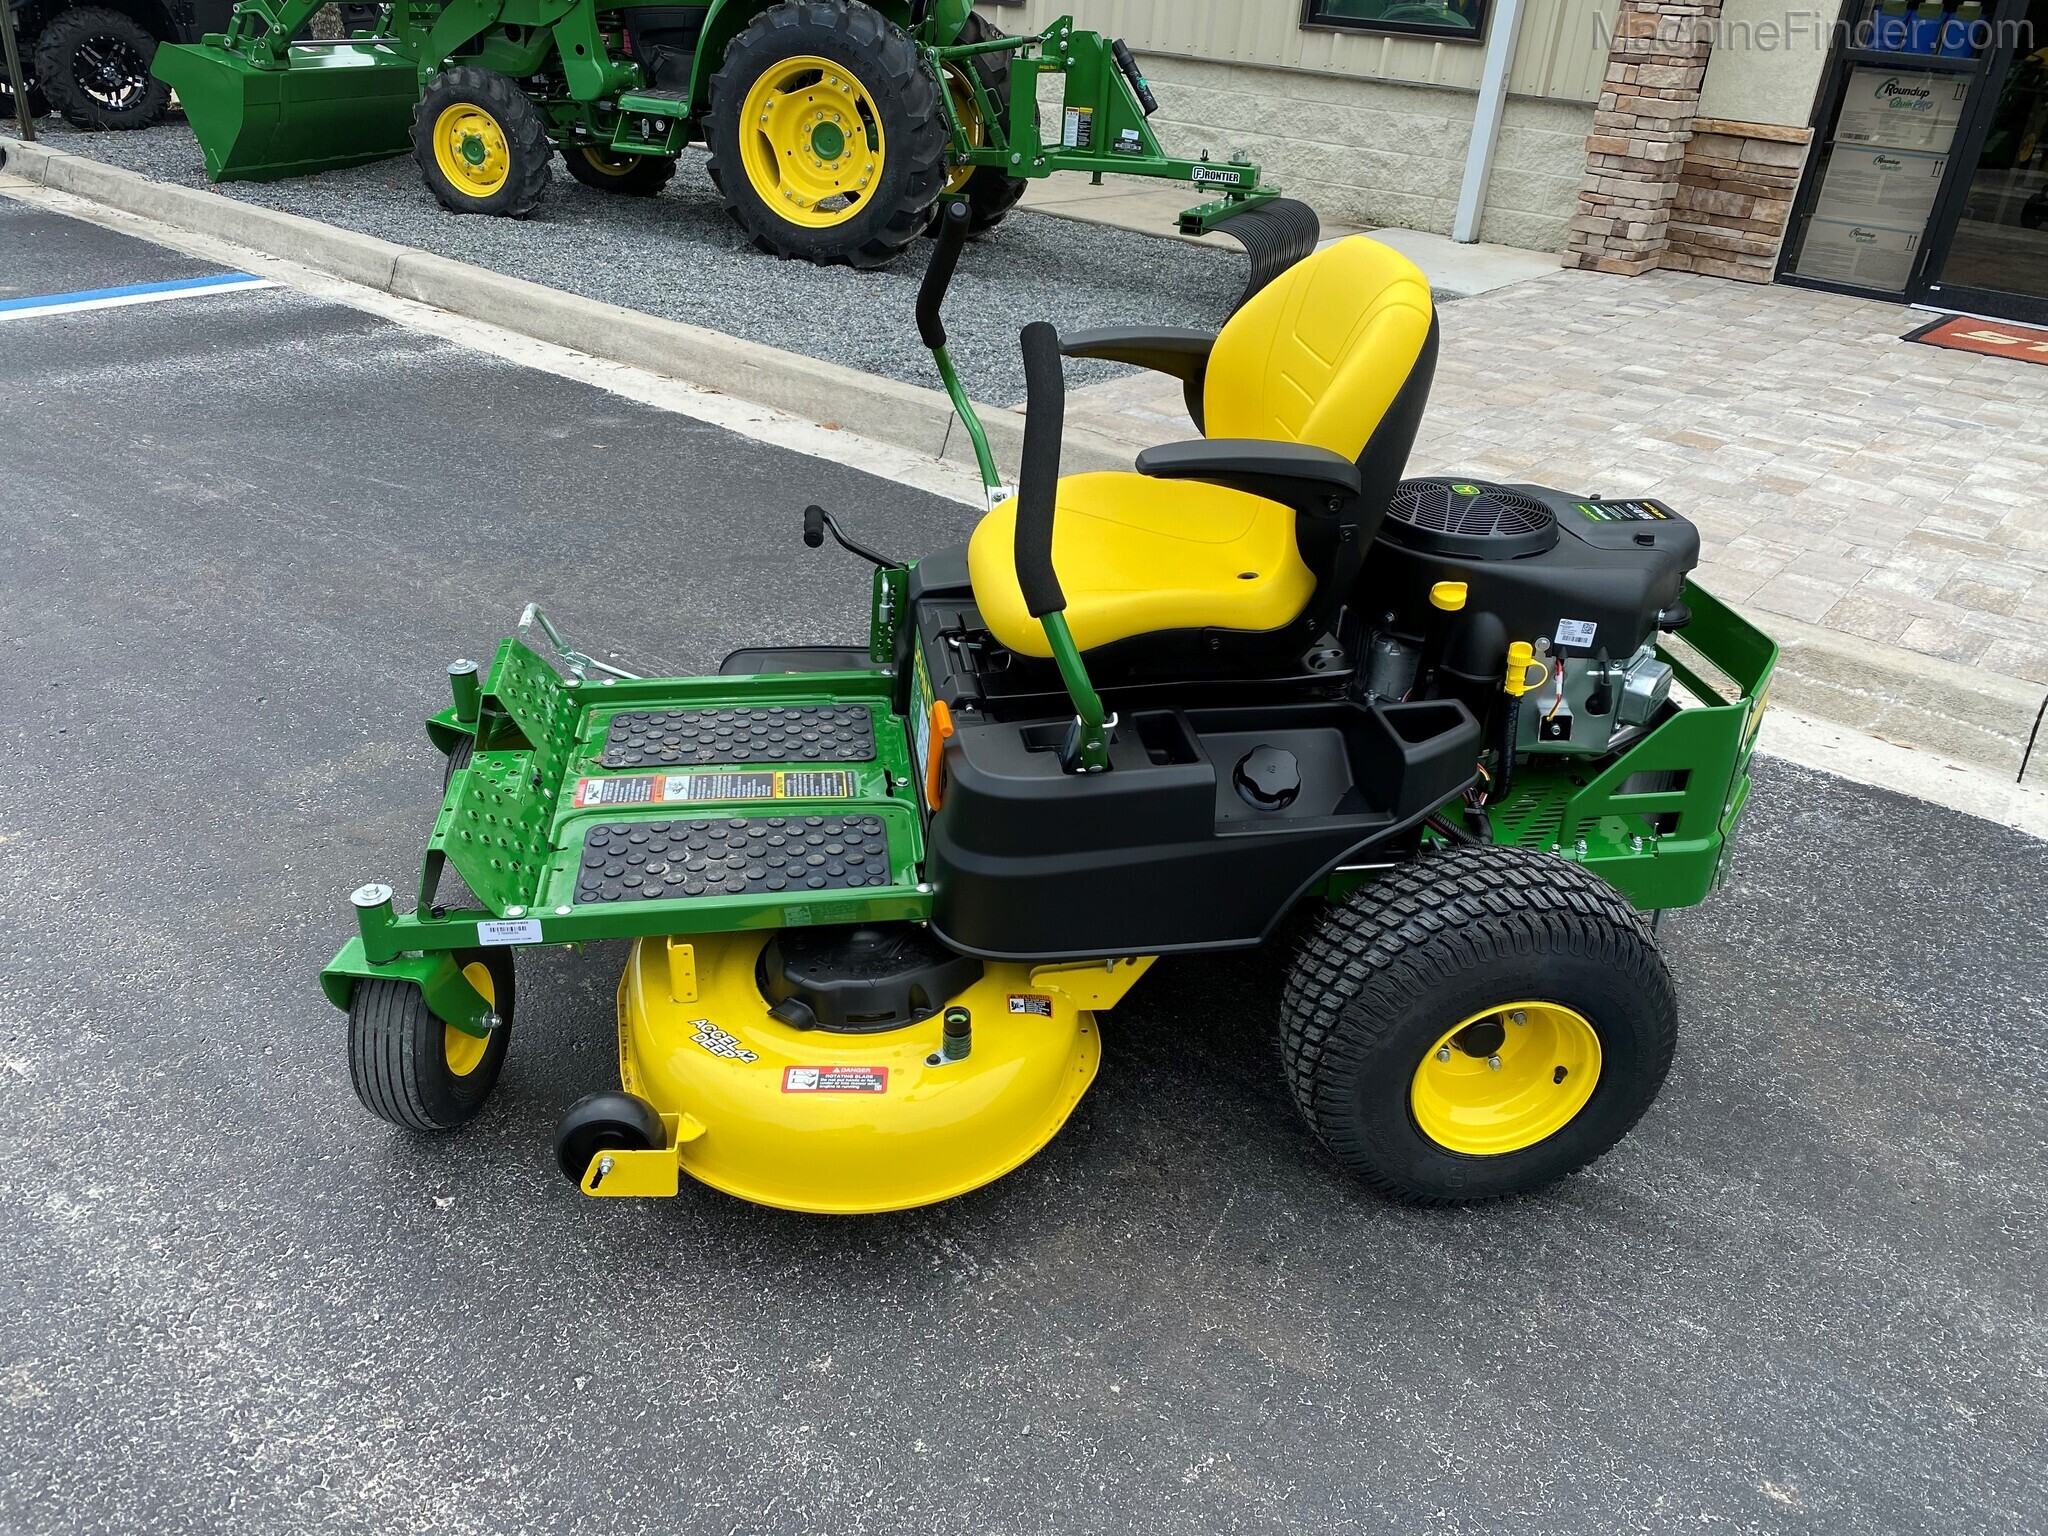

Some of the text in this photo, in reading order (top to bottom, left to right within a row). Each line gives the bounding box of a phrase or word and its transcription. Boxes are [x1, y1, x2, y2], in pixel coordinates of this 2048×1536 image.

[1883, 83, 1930, 100] Roundup
[1193, 167, 1239, 182] FRONTIER
[687, 1019, 742, 1051] ACCEL
[689, 1032, 737, 1058] DEEP
[734, 1049, 759, 1064] 42
